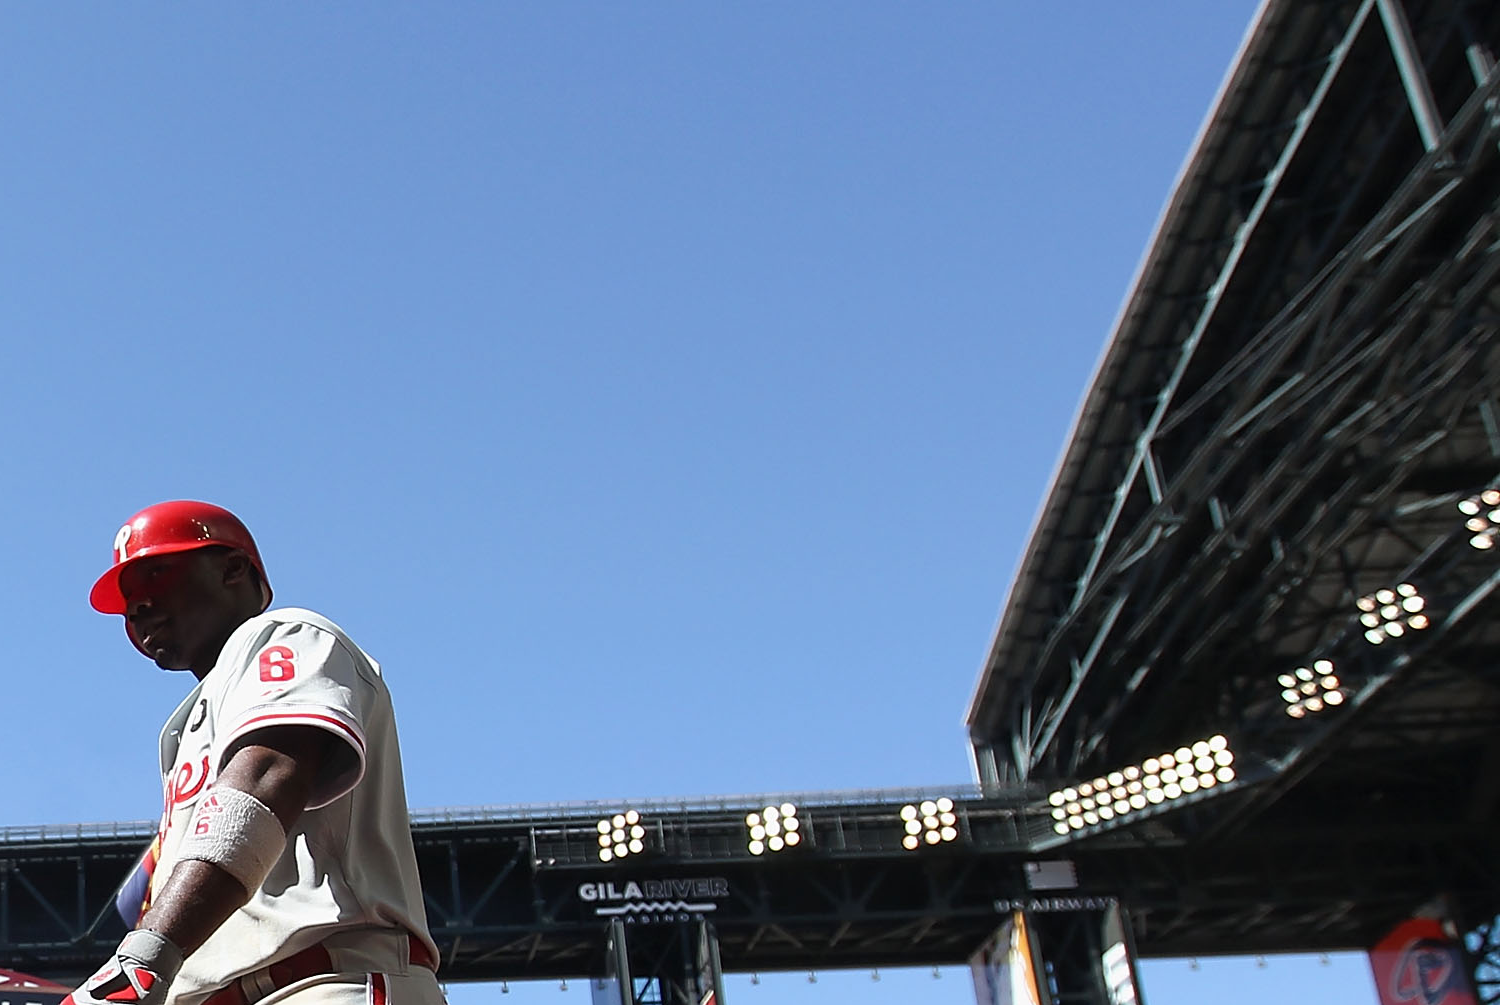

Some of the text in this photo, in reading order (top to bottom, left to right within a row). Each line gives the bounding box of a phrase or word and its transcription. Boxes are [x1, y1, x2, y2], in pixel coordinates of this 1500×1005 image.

[259, 645, 296, 683] 6
[194, 816, 212, 836] 6
[579, 877, 730, 901] GILA RIVER
